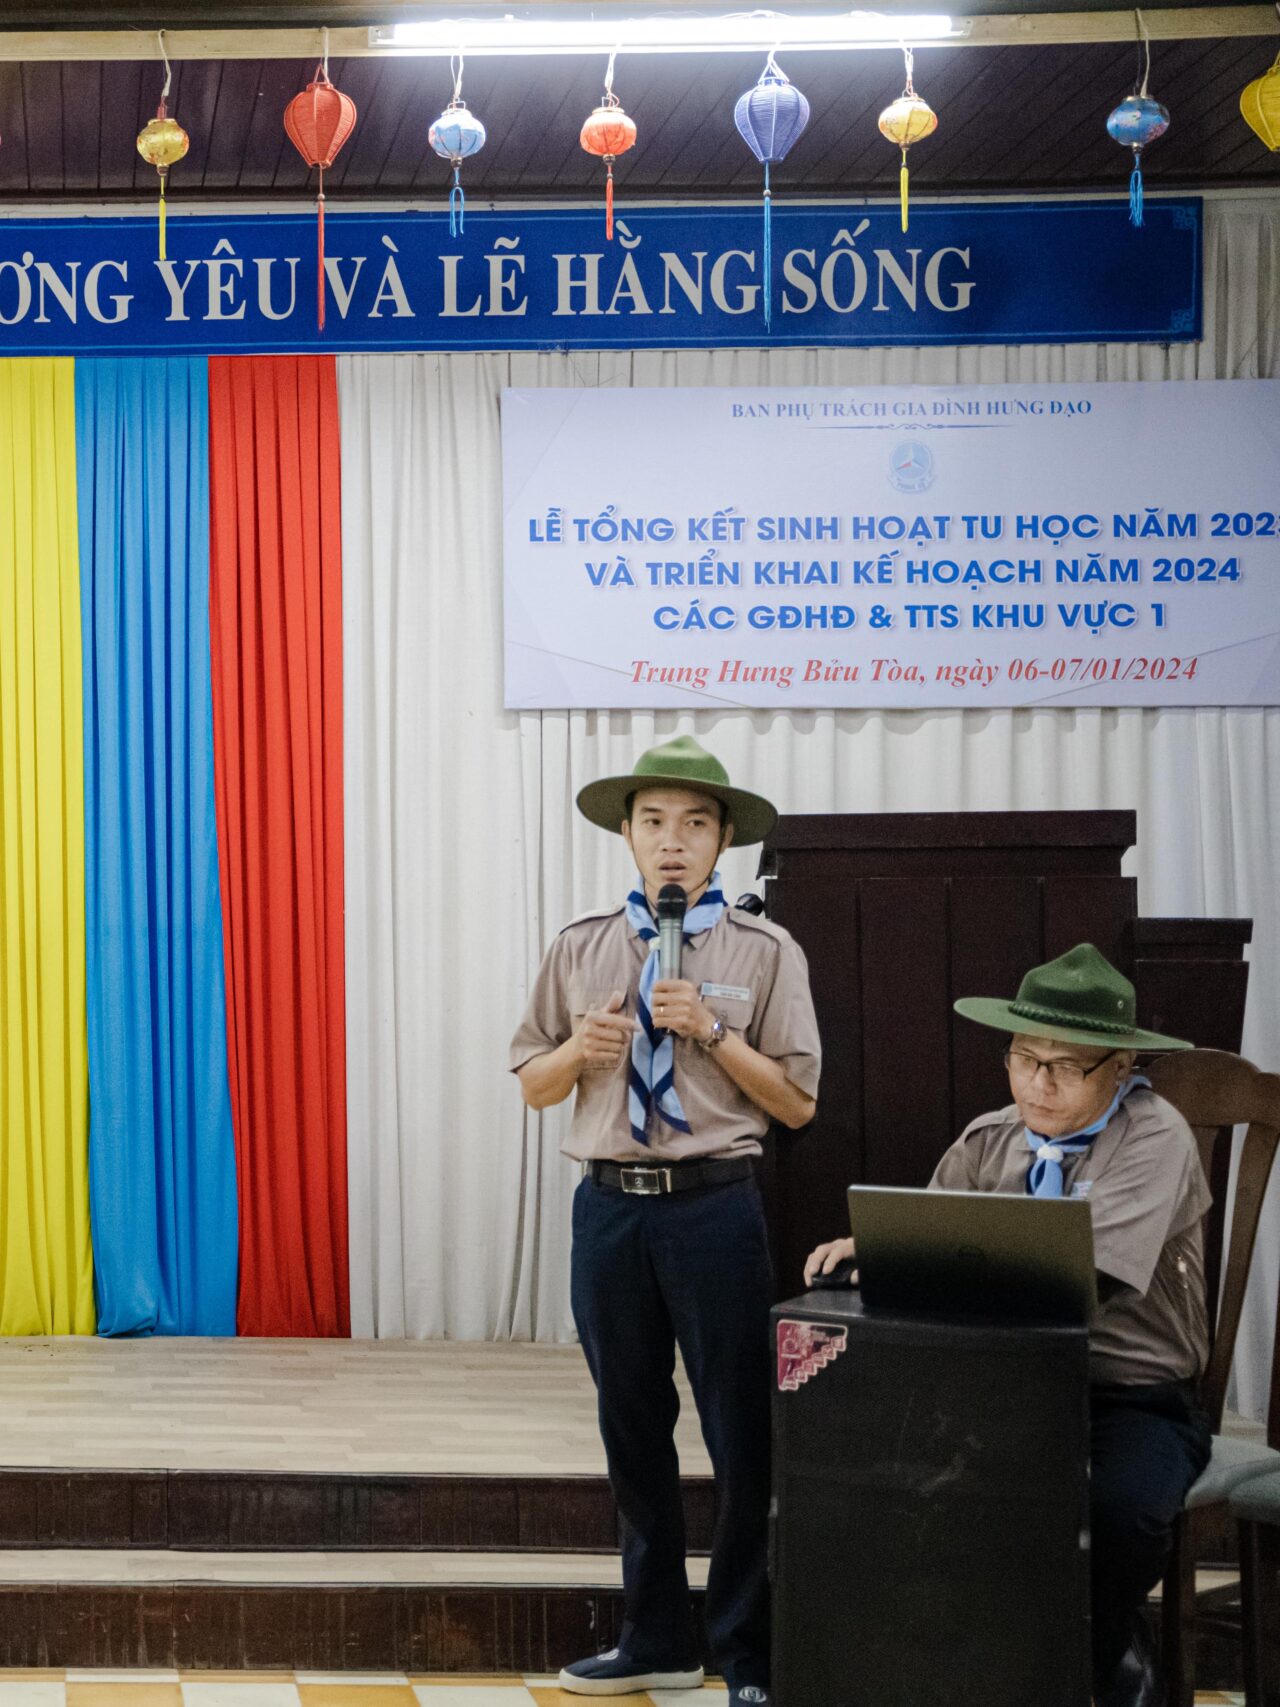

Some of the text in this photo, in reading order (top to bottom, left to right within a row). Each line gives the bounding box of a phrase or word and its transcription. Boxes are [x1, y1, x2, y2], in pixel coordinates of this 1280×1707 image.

[154, 238, 302, 322] YÊU
[321, 234, 415, 319] VÀ
[438, 236, 528, 317] LẼ
[552, 220, 764, 316] HẰNG
[781, 218, 976, 314] SỐNG
[732, 398, 1092, 420] BAN PHỤ TRÁCH GIA ĐÌNH HƯNG ĐẠO
[528, 504, 1280, 546] LỄ TỔNG KẾT SINH HOẠT TU HỌC NĂM 202
[585, 548, 1241, 591] VÀ TRIỂN KHAI KẾ HOẠCH NĂM 2024
[653, 599, 1166, 635] CÁC GĐHĐ & TTS KHU VỰC 1
[631, 656, 1200, 689] Trung Hưng Bửu Tòa, ngày 06-07/01/2024
